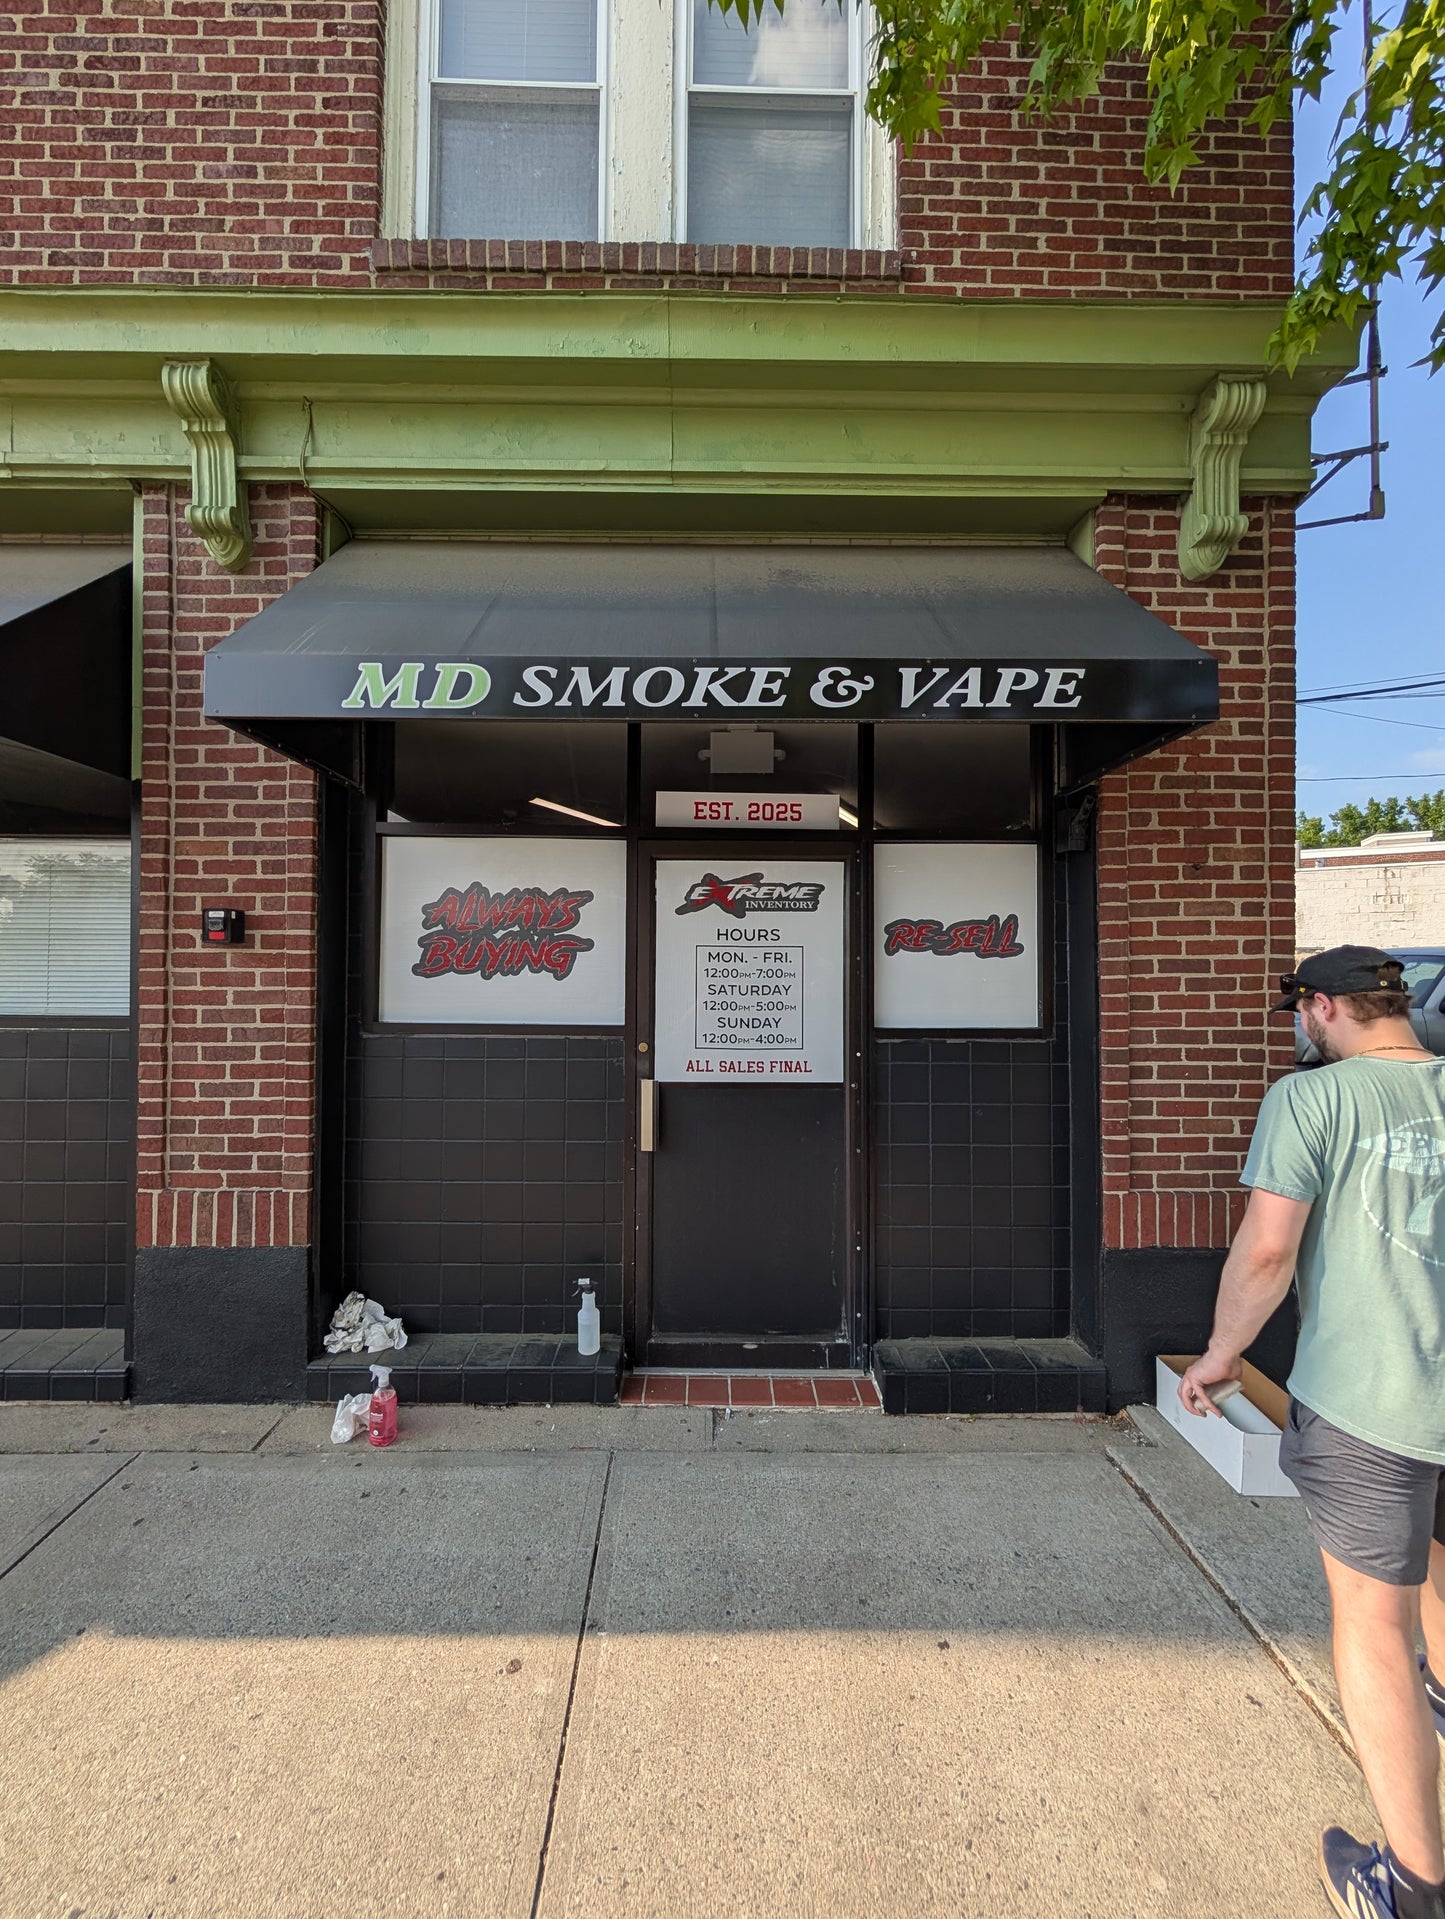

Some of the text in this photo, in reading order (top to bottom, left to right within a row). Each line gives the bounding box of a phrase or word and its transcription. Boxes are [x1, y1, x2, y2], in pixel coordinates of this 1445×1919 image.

[341, 662, 1086, 709] MD SMOKE & VAPE
[694, 801, 802, 821] EST. 2025
[683, 874, 822, 914] EXTREME
[425, 886, 590, 932] ALWAYS
[745, 900, 815, 909] INVENTORY
[717, 928, 781, 941] HOURS
[887, 917, 1021, 956] RE-SELL
[415, 934, 590, 977] BUYING
[708, 951, 748, 964] MON.
[763, 952, 792, 964] FRI.
[708, 983, 792, 996] SATURDAY
[717, 1017, 782, 1029] SUNDAY
[685, 1060, 812, 1073] ALL SALES FINAL
